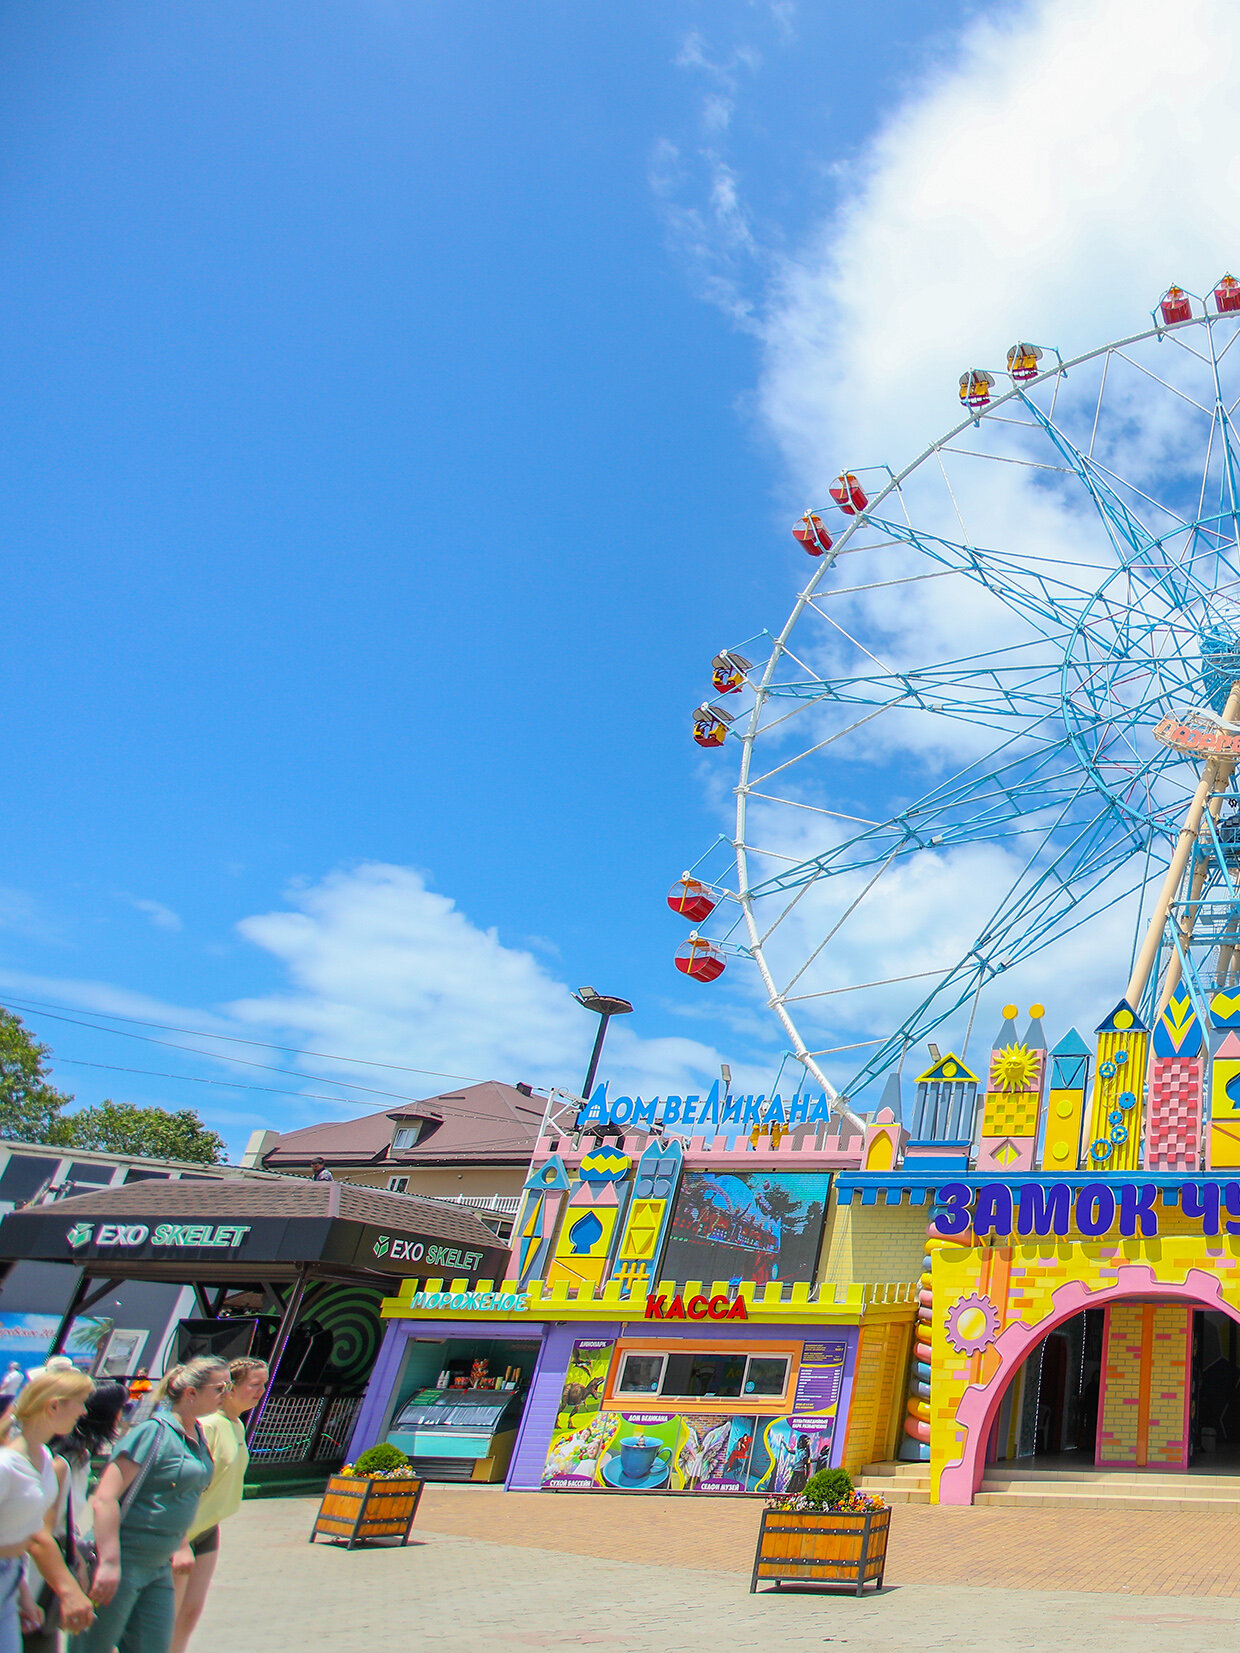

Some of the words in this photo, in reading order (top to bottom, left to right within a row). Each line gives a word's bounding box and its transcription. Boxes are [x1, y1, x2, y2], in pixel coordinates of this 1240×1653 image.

[932, 1182, 1158, 1238] ЗАМОК
[96, 1223, 149, 1247] EXO
[151, 1223, 251, 1247] SKELET
[389, 1239, 424, 1262] EXO
[425, 1246, 484, 1271] SKELET
[410, 1291, 531, 1312] МОРОЖЕНОЕ
[644, 1294, 748, 1320] КАССА
[550, 1479, 567, 1487] СУХОЙ
[568, 1479, 591, 1487] БАССЕЙН
[720, 1483, 740, 1491] МУЗЕЙ
